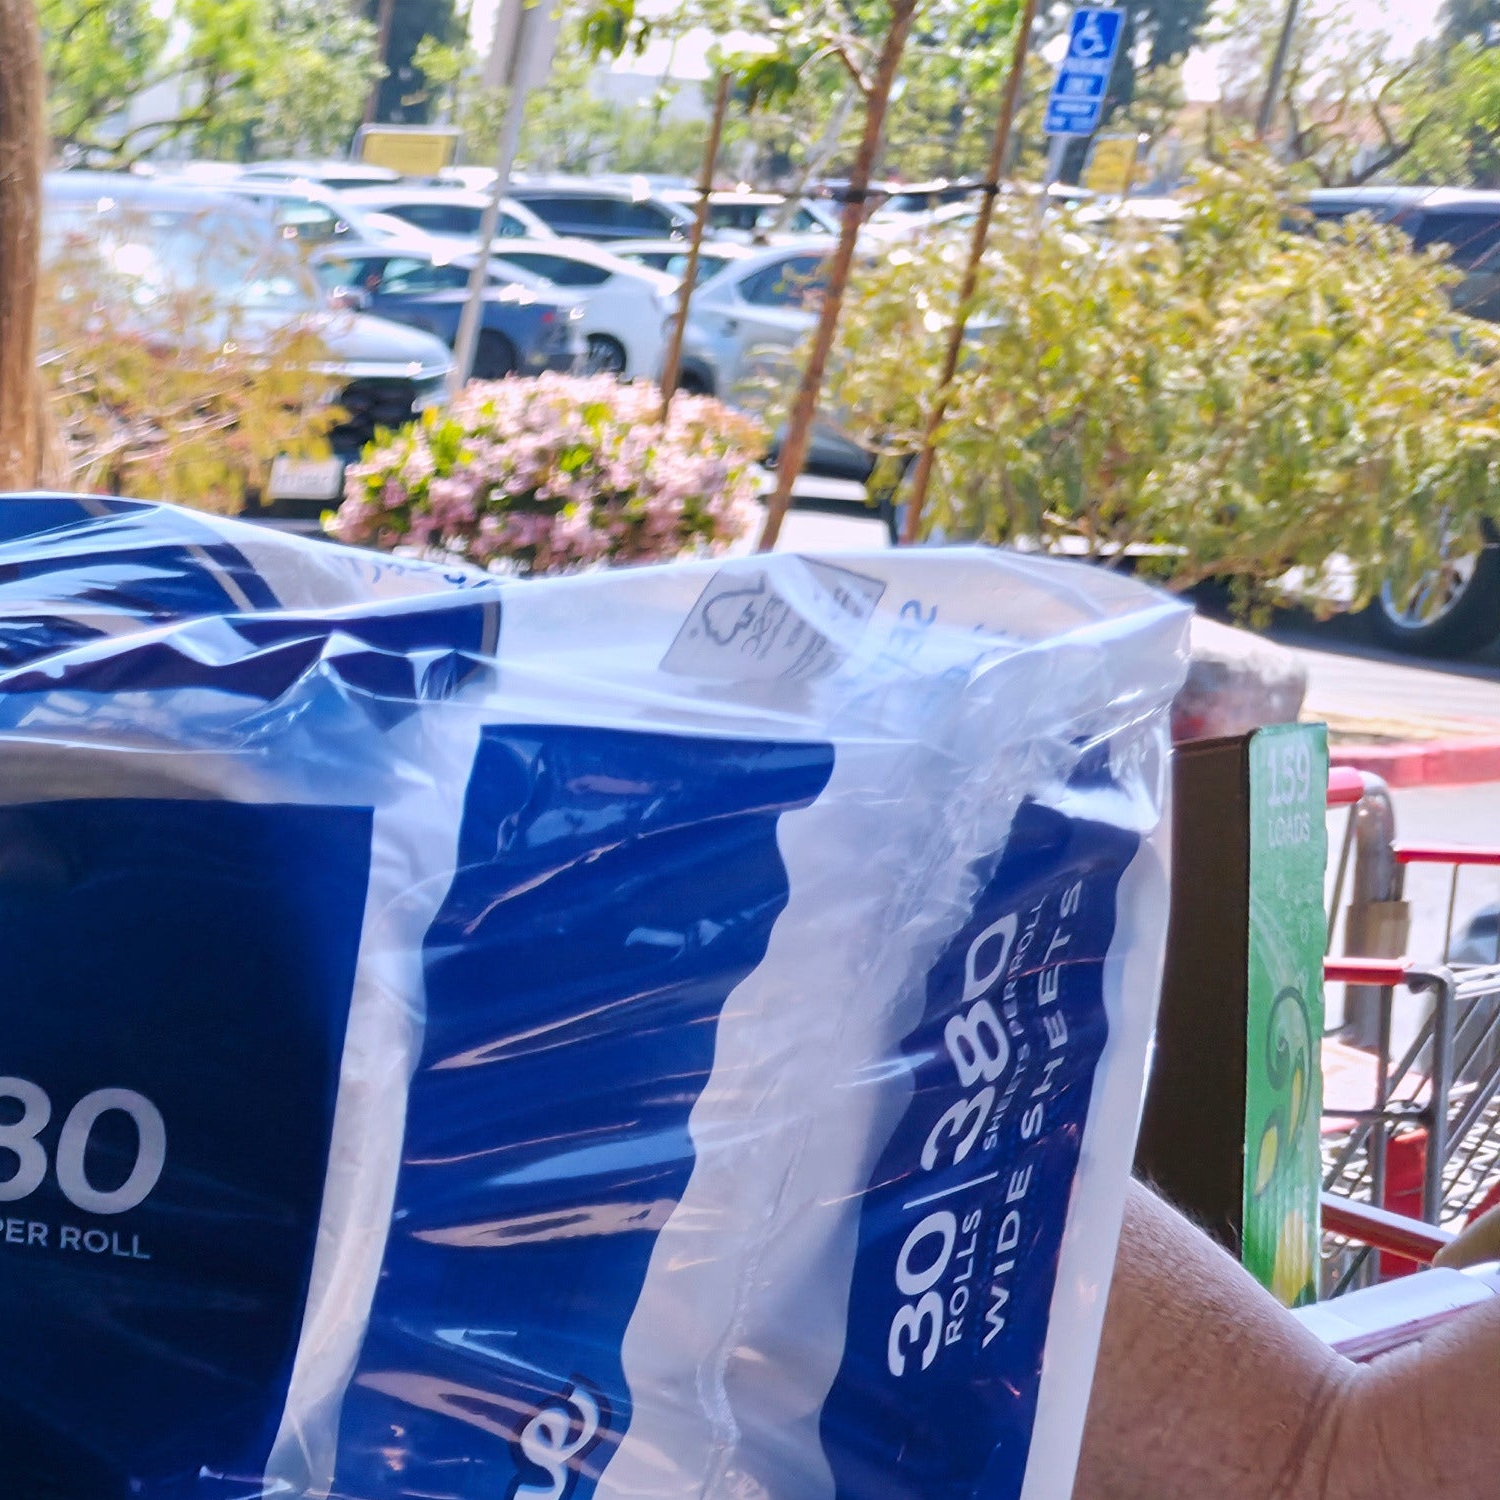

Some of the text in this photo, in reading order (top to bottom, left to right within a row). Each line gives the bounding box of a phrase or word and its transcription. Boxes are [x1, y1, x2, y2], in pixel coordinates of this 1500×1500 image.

[1267, 742, 1311, 806] 159
[919, 912, 1019, 1172] 380
[981, 878, 1084, 1349] WIDE SHEETS
[57, 1220, 152, 1262] ROLL
[886, 1208, 958, 1378] 30
[943, 1208, 984, 1347] ROLLS
